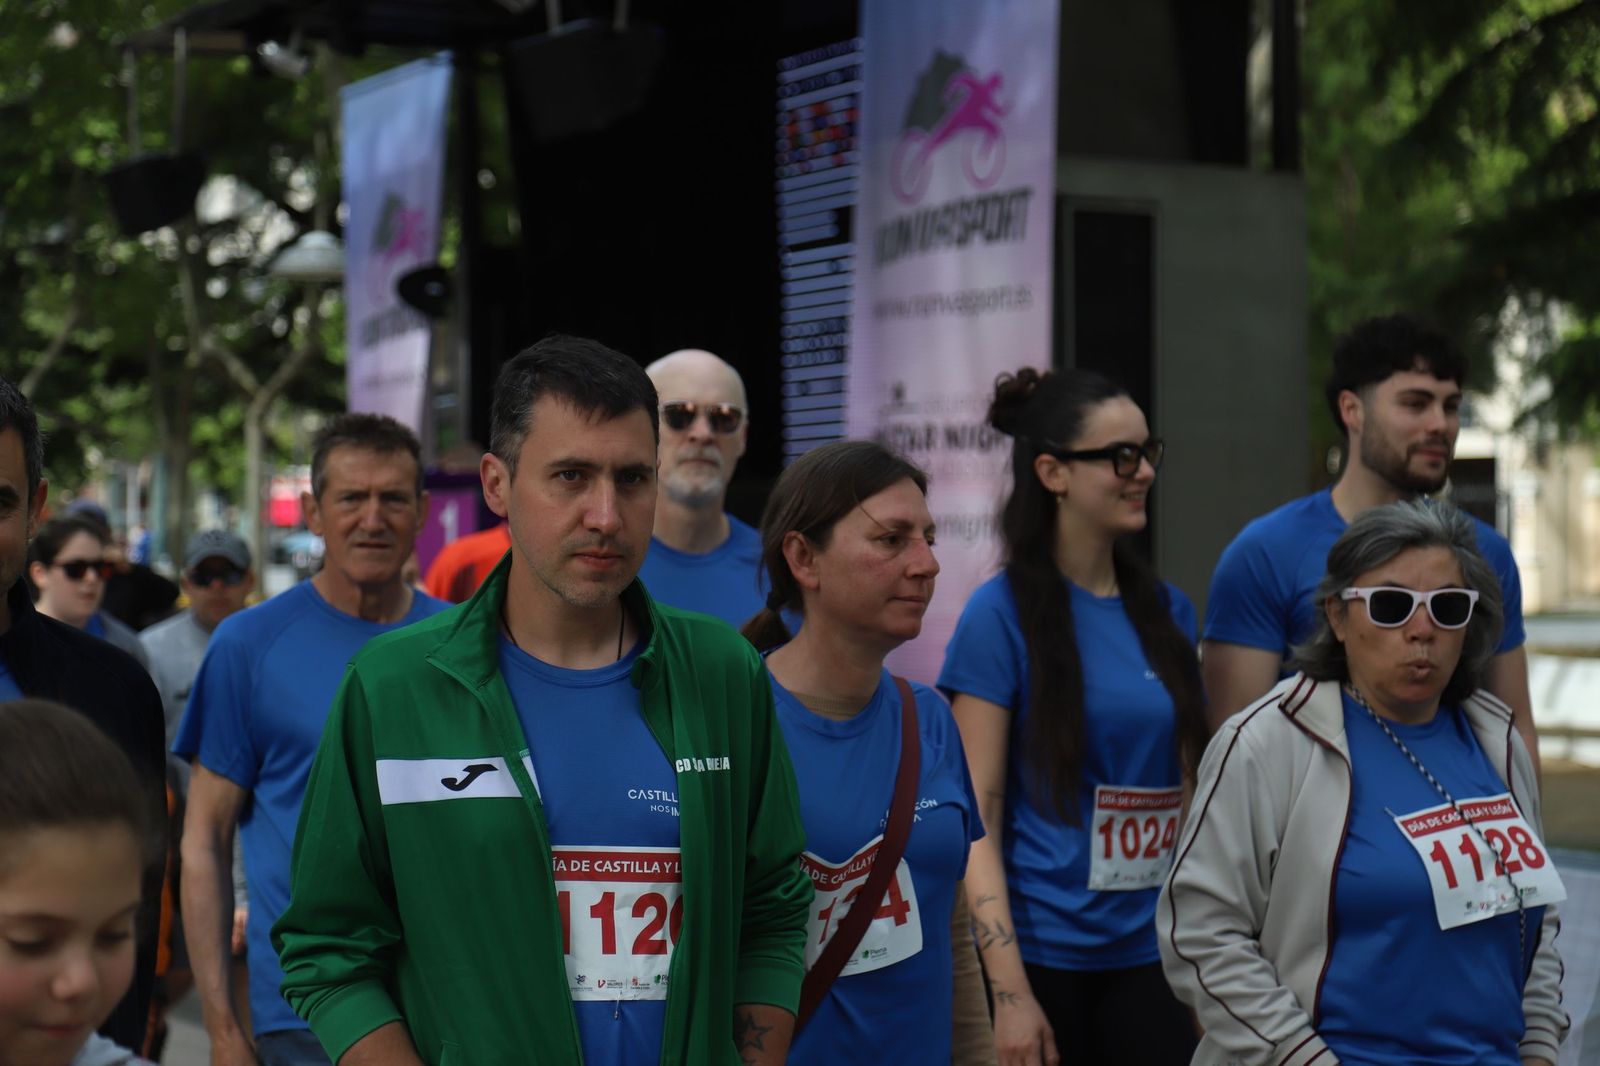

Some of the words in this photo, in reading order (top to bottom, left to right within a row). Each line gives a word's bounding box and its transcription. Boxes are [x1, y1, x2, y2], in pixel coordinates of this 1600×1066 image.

[675, 758, 692, 773] CD
[627, 789, 679, 803] CASTILL
[650, 804, 670, 813] NOS
[914, 798, 938, 811] EÓN
[1426, 816, 1442, 829] DE
[1442, 806, 1483, 824] CASILLA
[1098, 815, 1178, 861] 1024
[1430, 825, 1546, 889] 1128
[552, 856, 567, 872] ÍA
[570, 859, 591, 873] DE
[594, 860, 661, 874] CASTILLA
[663, 861, 672, 874] Y
[811, 869, 829, 884] DE
